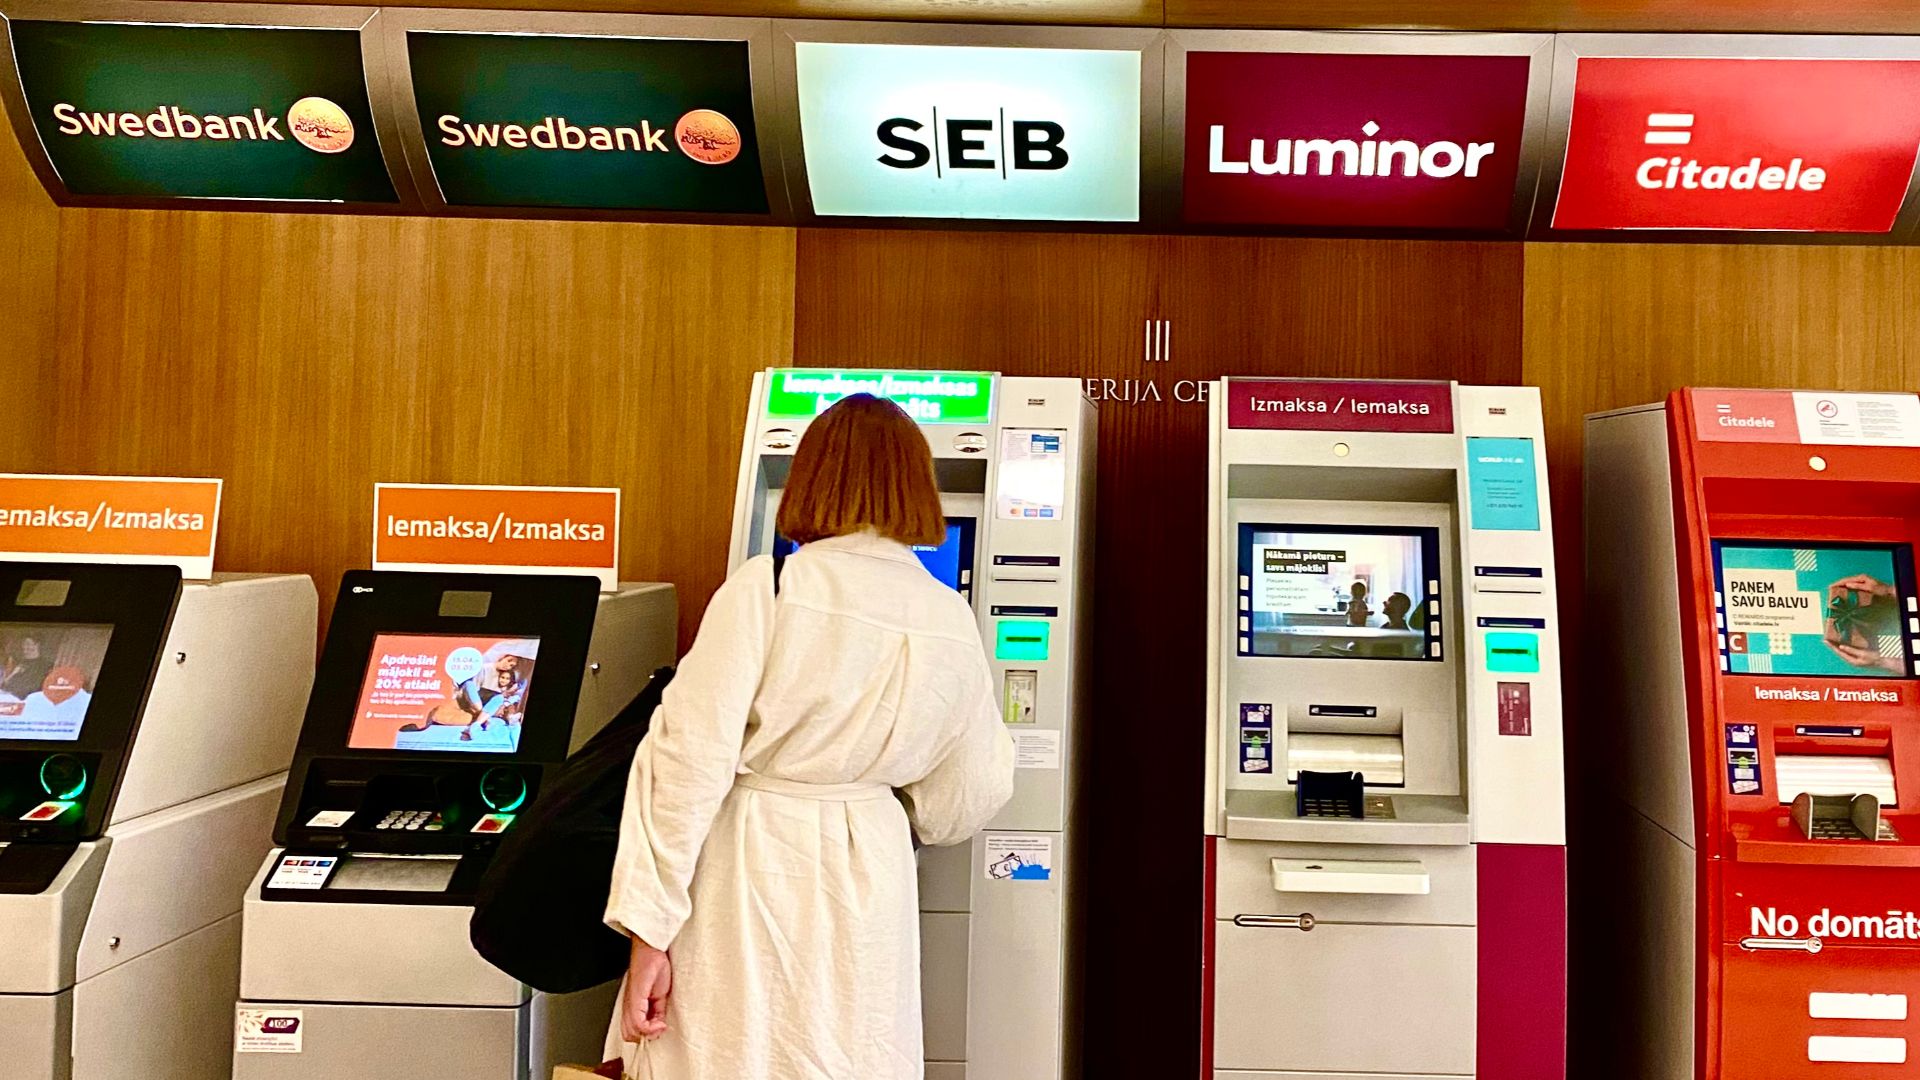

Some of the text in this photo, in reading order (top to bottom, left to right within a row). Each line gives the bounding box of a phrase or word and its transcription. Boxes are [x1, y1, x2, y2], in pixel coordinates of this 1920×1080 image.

[53, 103, 286, 142] Swedbank
[437, 114, 670, 154] Swedbank
[1209, 120, 1495, 179] Luminor
[1635, 156, 1827, 191] Citadele
[1250, 396, 1430, 415] Izmaksa / Iemaksa
[1718, 415, 1775, 428] Citadele
[387, 512, 605, 543] Iemaksa/Izmaksa
[1265, 550, 1301, 560] Nākamā
[1303, 551, 1336, 562] pietura
[1731, 581, 1775, 595] PAŅEM
[1732, 595, 1809, 609] SAVU BALVU
[1729, 634, 1743, 651] C
[381, 654, 438, 667] Apdrošini
[422, 669, 436, 678] ar
[374, 678, 402, 689] 20%
[1754, 686, 1899, 703] Iemaksa / Izmaksa
[1751, 906, 1799, 937] No
